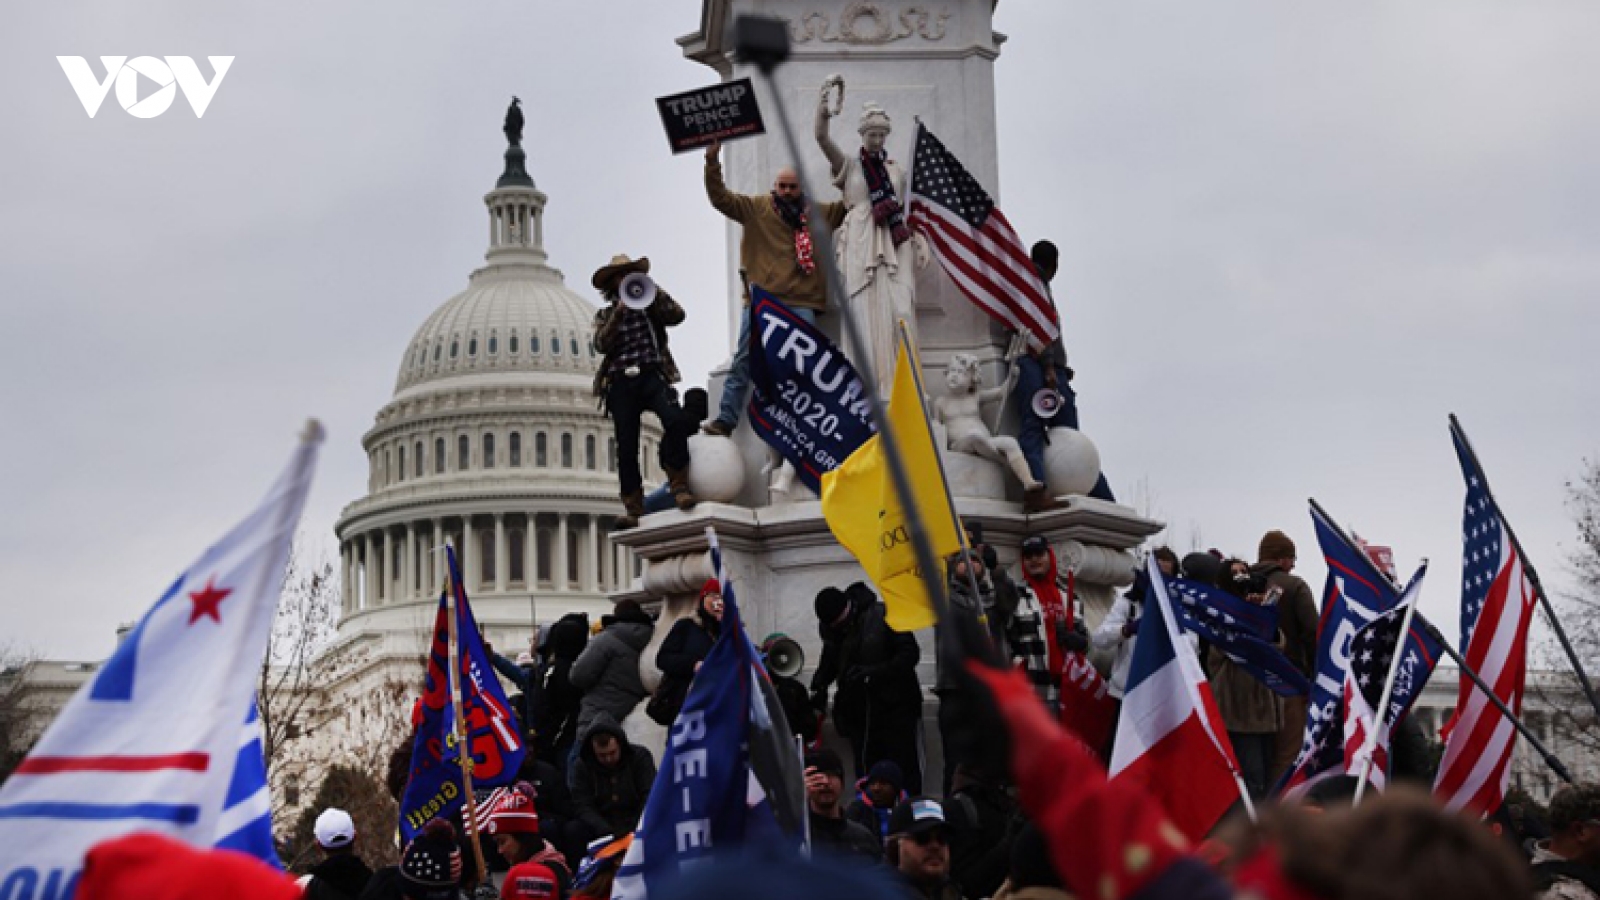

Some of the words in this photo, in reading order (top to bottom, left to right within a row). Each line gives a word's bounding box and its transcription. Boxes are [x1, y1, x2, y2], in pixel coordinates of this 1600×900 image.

[665, 84, 747, 116] TRUMP
[682, 103, 742, 129] PENCE
[761, 312, 877, 432] TRUM
